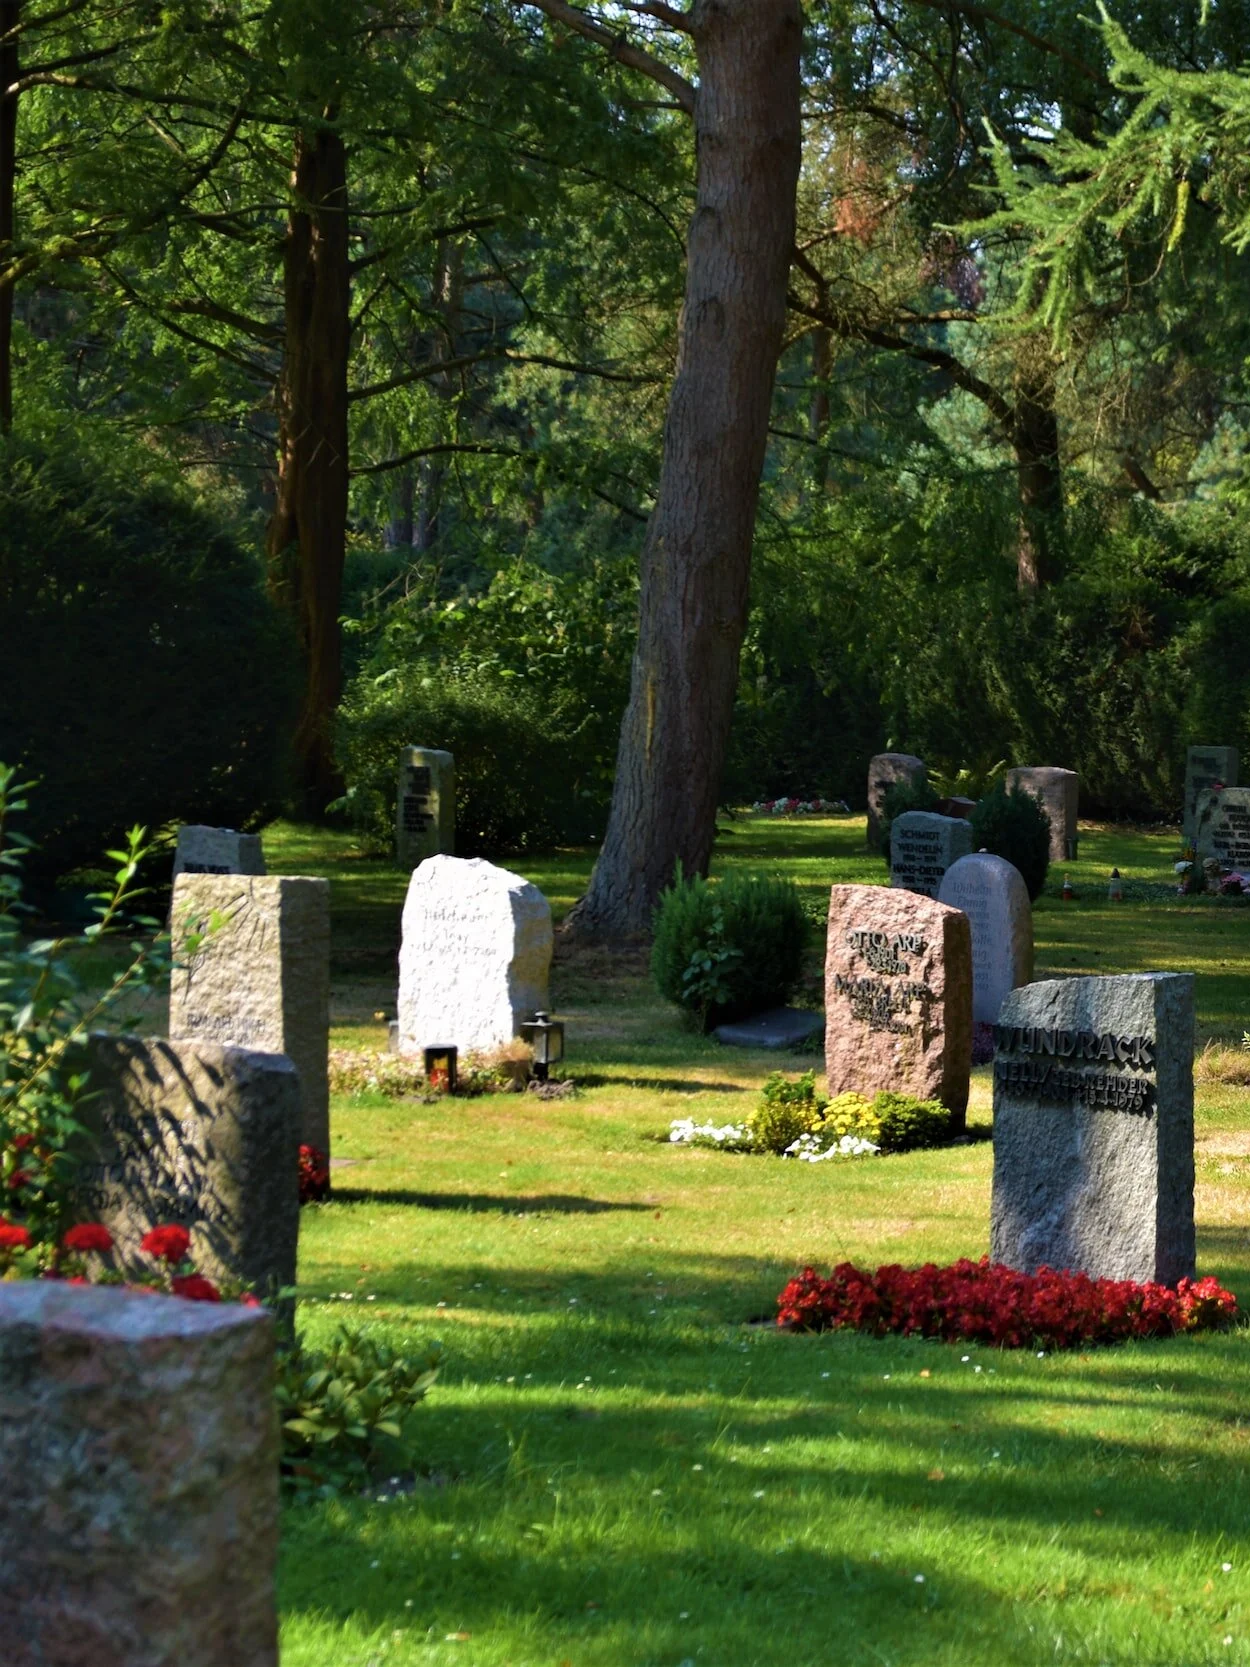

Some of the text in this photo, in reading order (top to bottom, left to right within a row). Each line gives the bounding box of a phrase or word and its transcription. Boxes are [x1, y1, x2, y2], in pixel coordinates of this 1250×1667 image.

[900, 829, 940, 841] SCHMIDT
[845, 930, 887, 949] OTTO
[993, 1026, 1153, 1064] WUNDRACK
